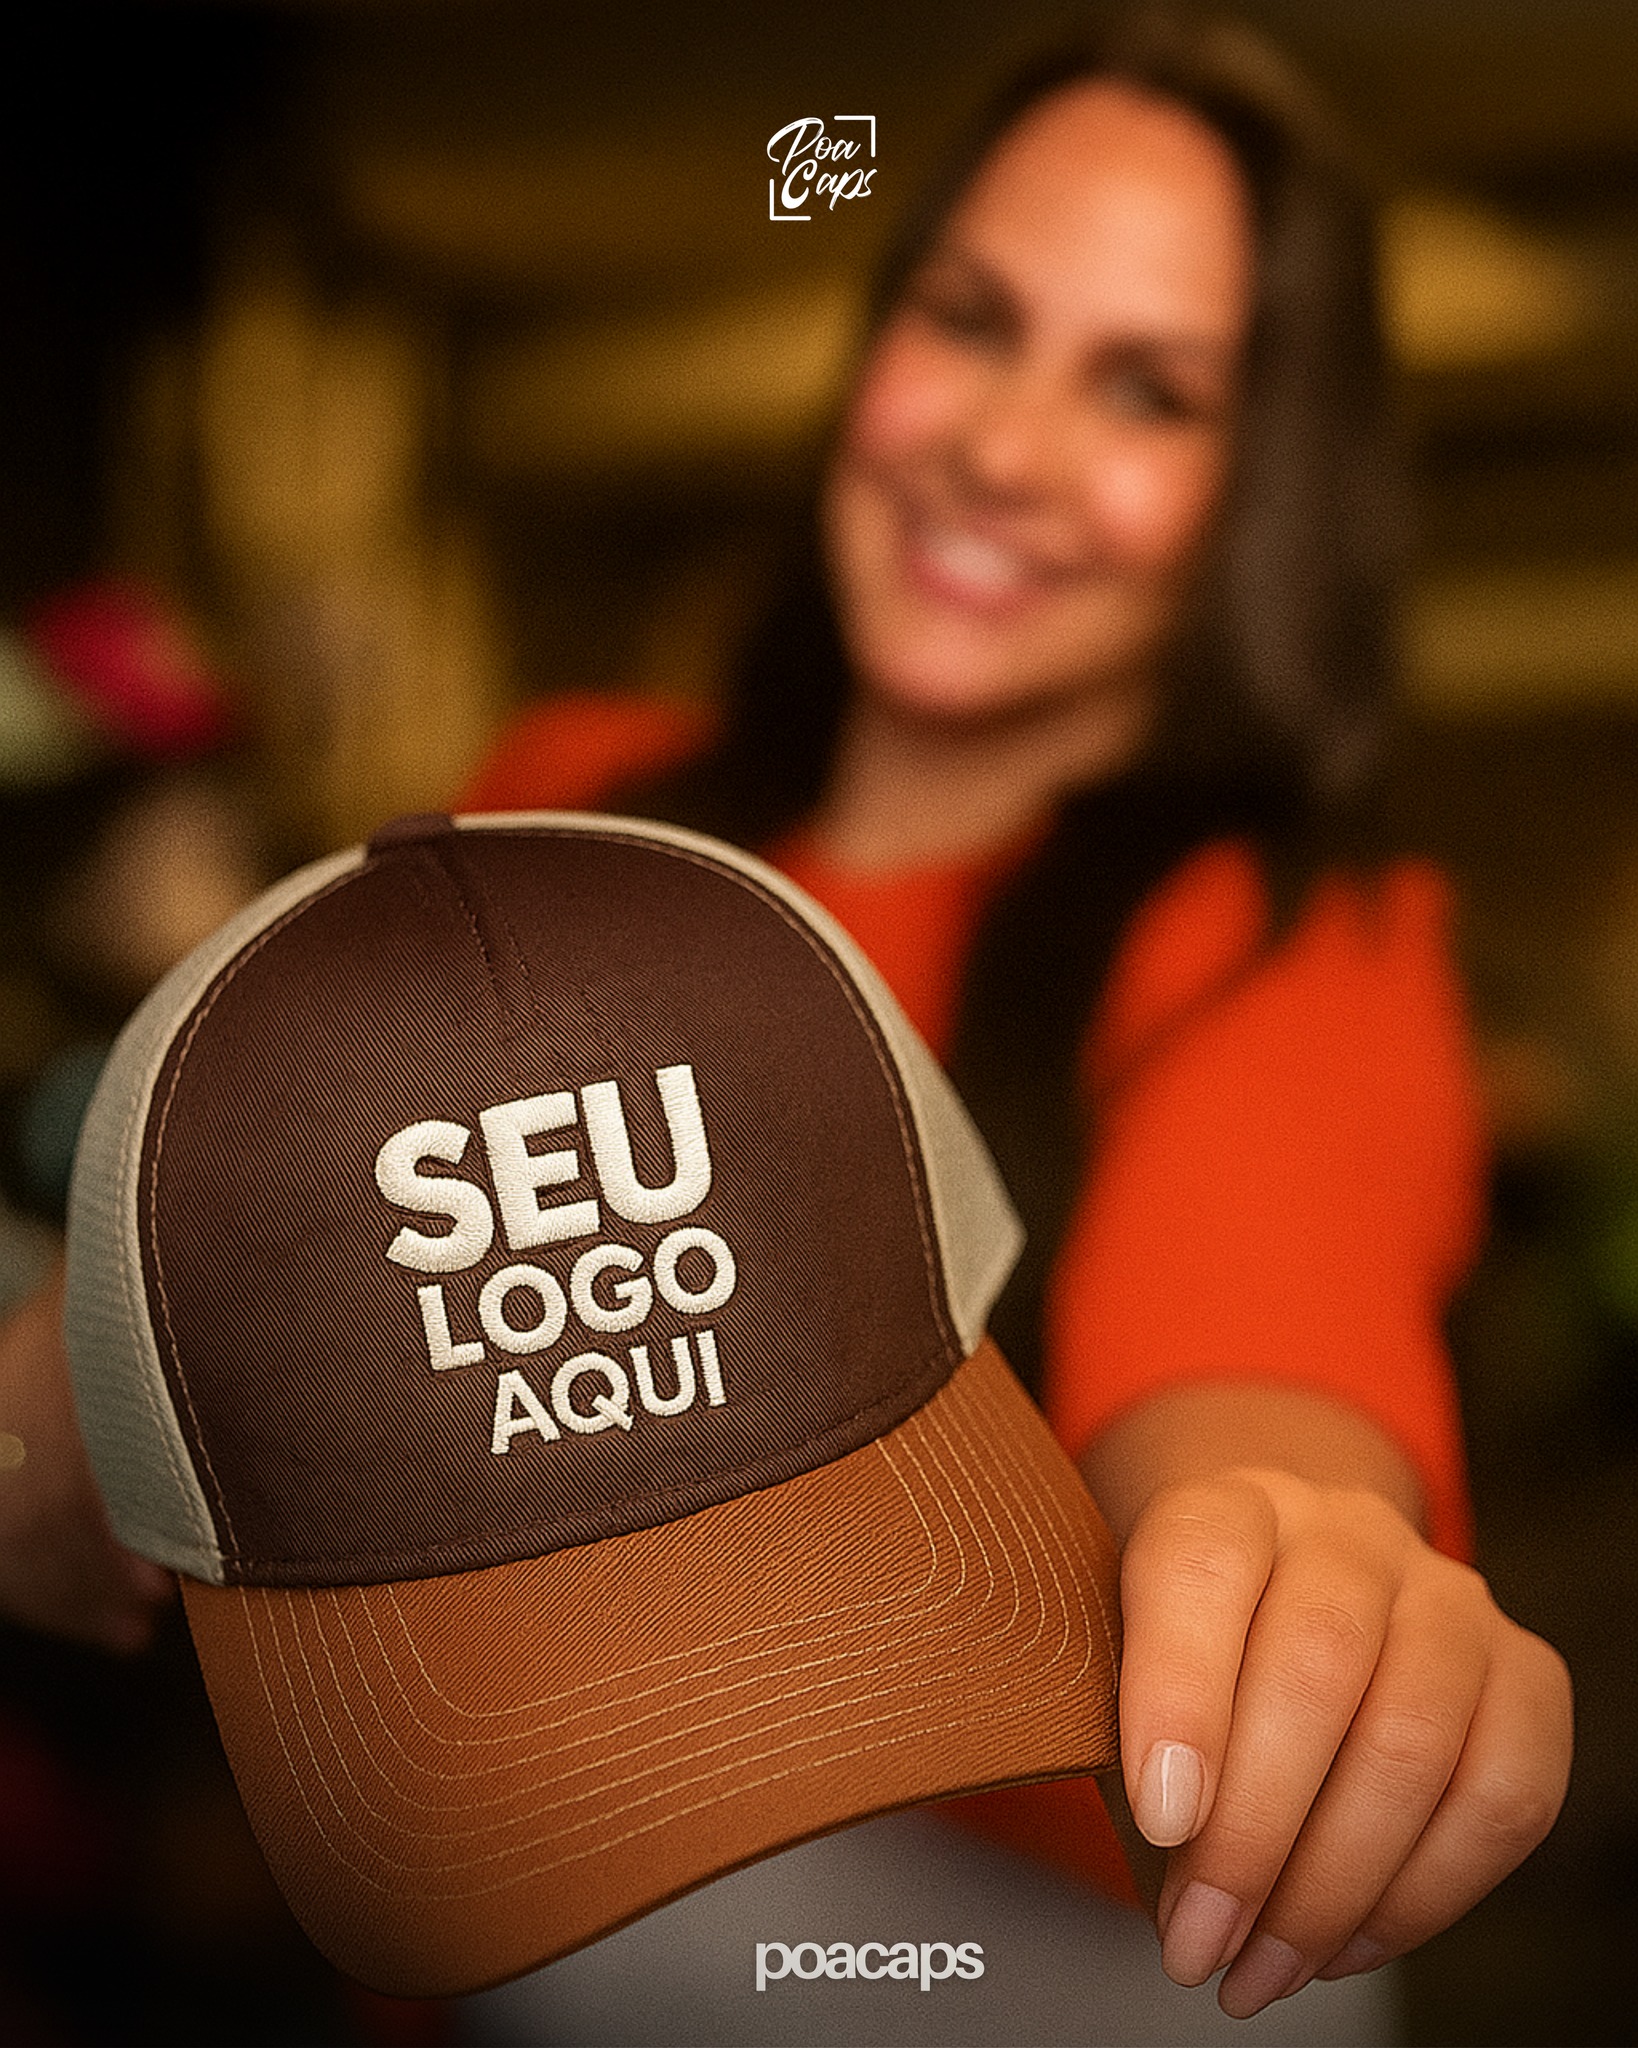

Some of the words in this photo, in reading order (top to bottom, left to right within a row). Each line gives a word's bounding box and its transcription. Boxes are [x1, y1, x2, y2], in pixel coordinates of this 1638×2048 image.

[375, 1064, 712, 1273] SEU
[417, 1227, 736, 1371] LOGO
[491, 1329, 727, 1455] AQUI
